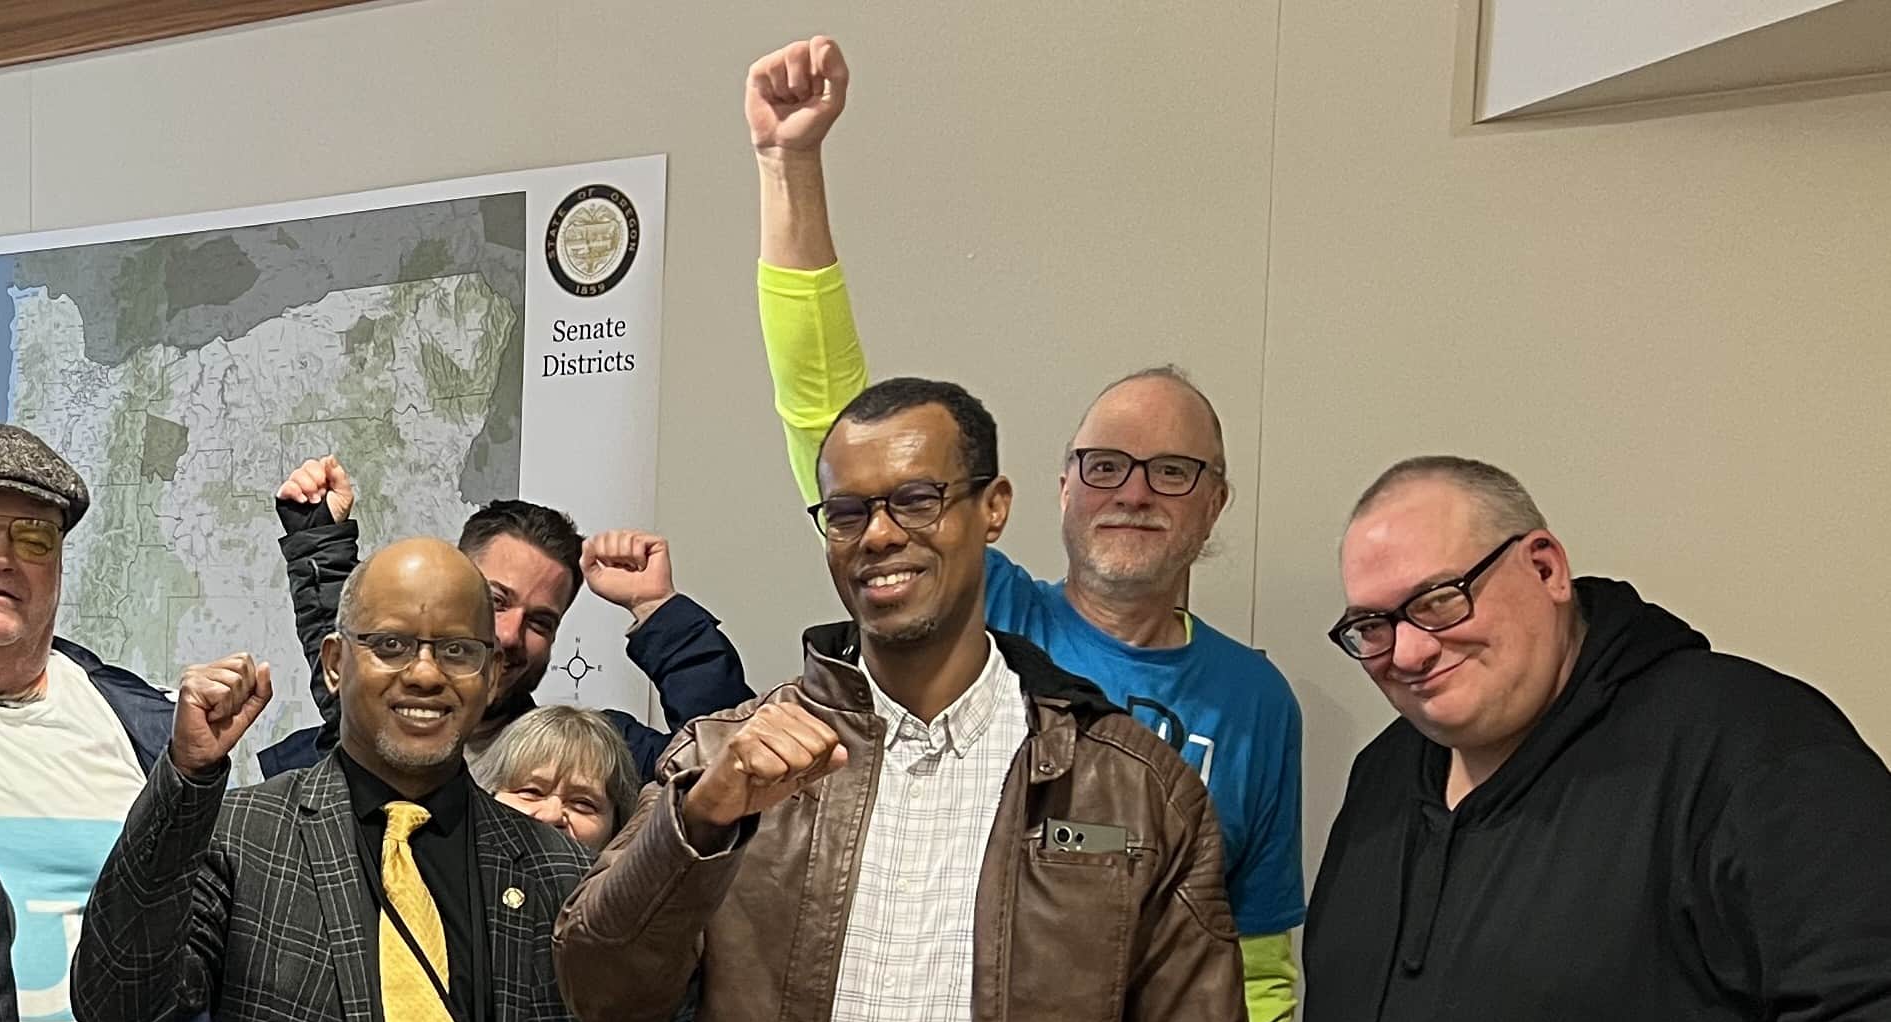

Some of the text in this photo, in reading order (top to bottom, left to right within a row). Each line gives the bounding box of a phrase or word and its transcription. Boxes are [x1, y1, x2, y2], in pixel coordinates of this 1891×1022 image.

[548, 188, 637, 259] STATE OF OREGON
[575, 283, 605, 295] 1859
[552, 317, 626, 343] Senate
[542, 349, 635, 377] Districts
